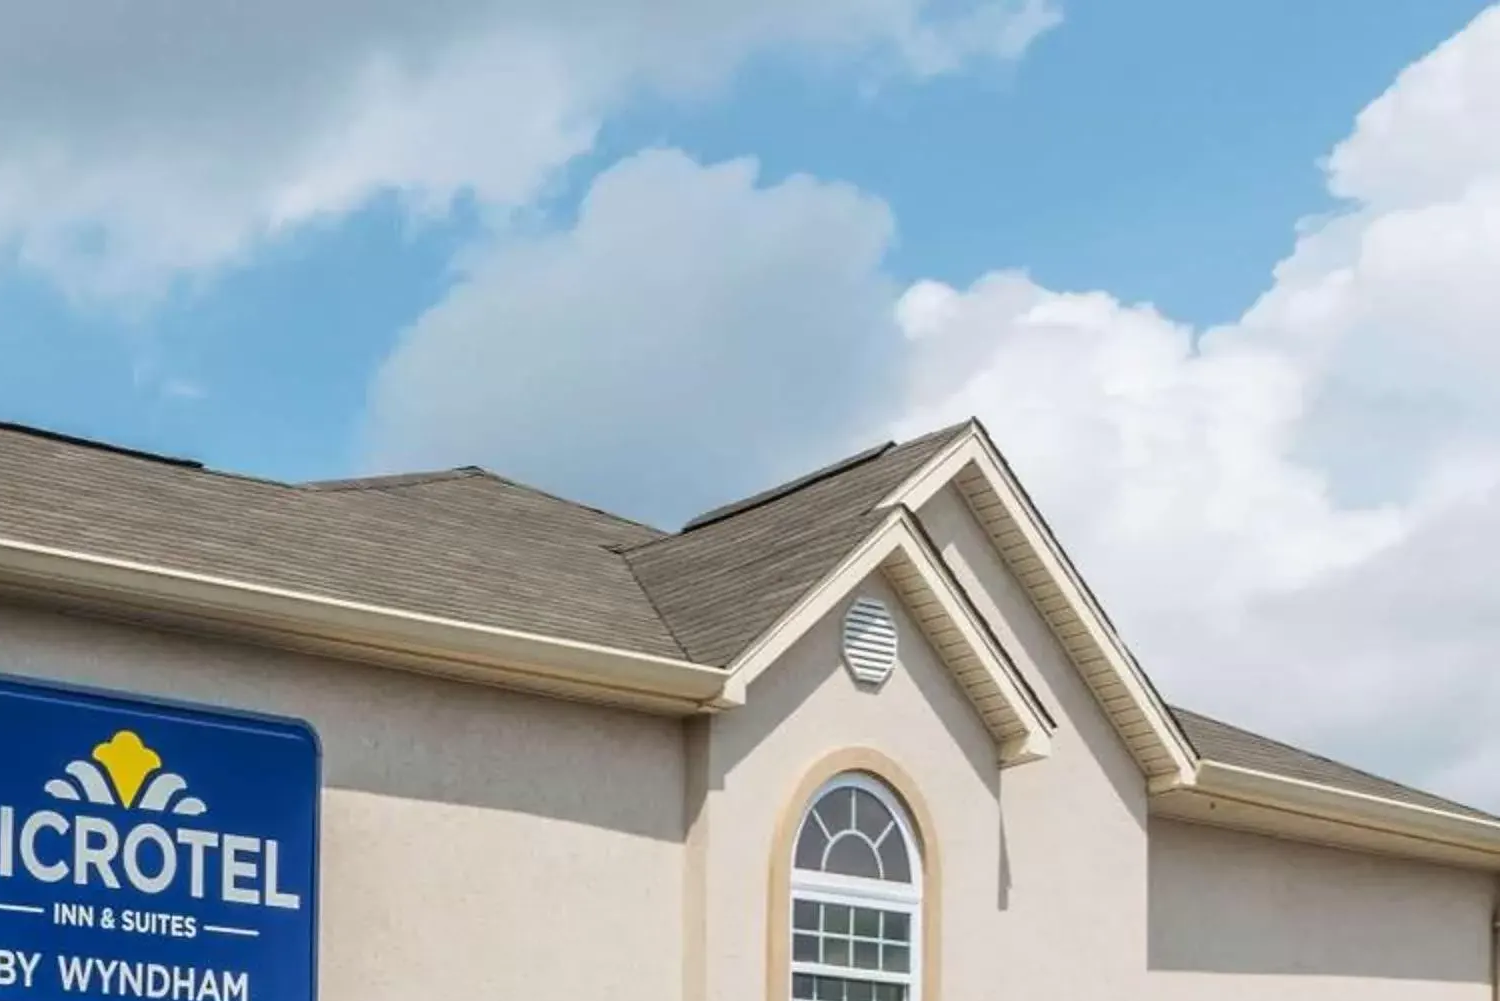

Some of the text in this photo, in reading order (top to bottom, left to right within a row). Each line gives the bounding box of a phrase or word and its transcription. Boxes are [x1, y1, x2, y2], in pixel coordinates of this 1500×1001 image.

[53, 903, 197, 938] INN & SUITES
